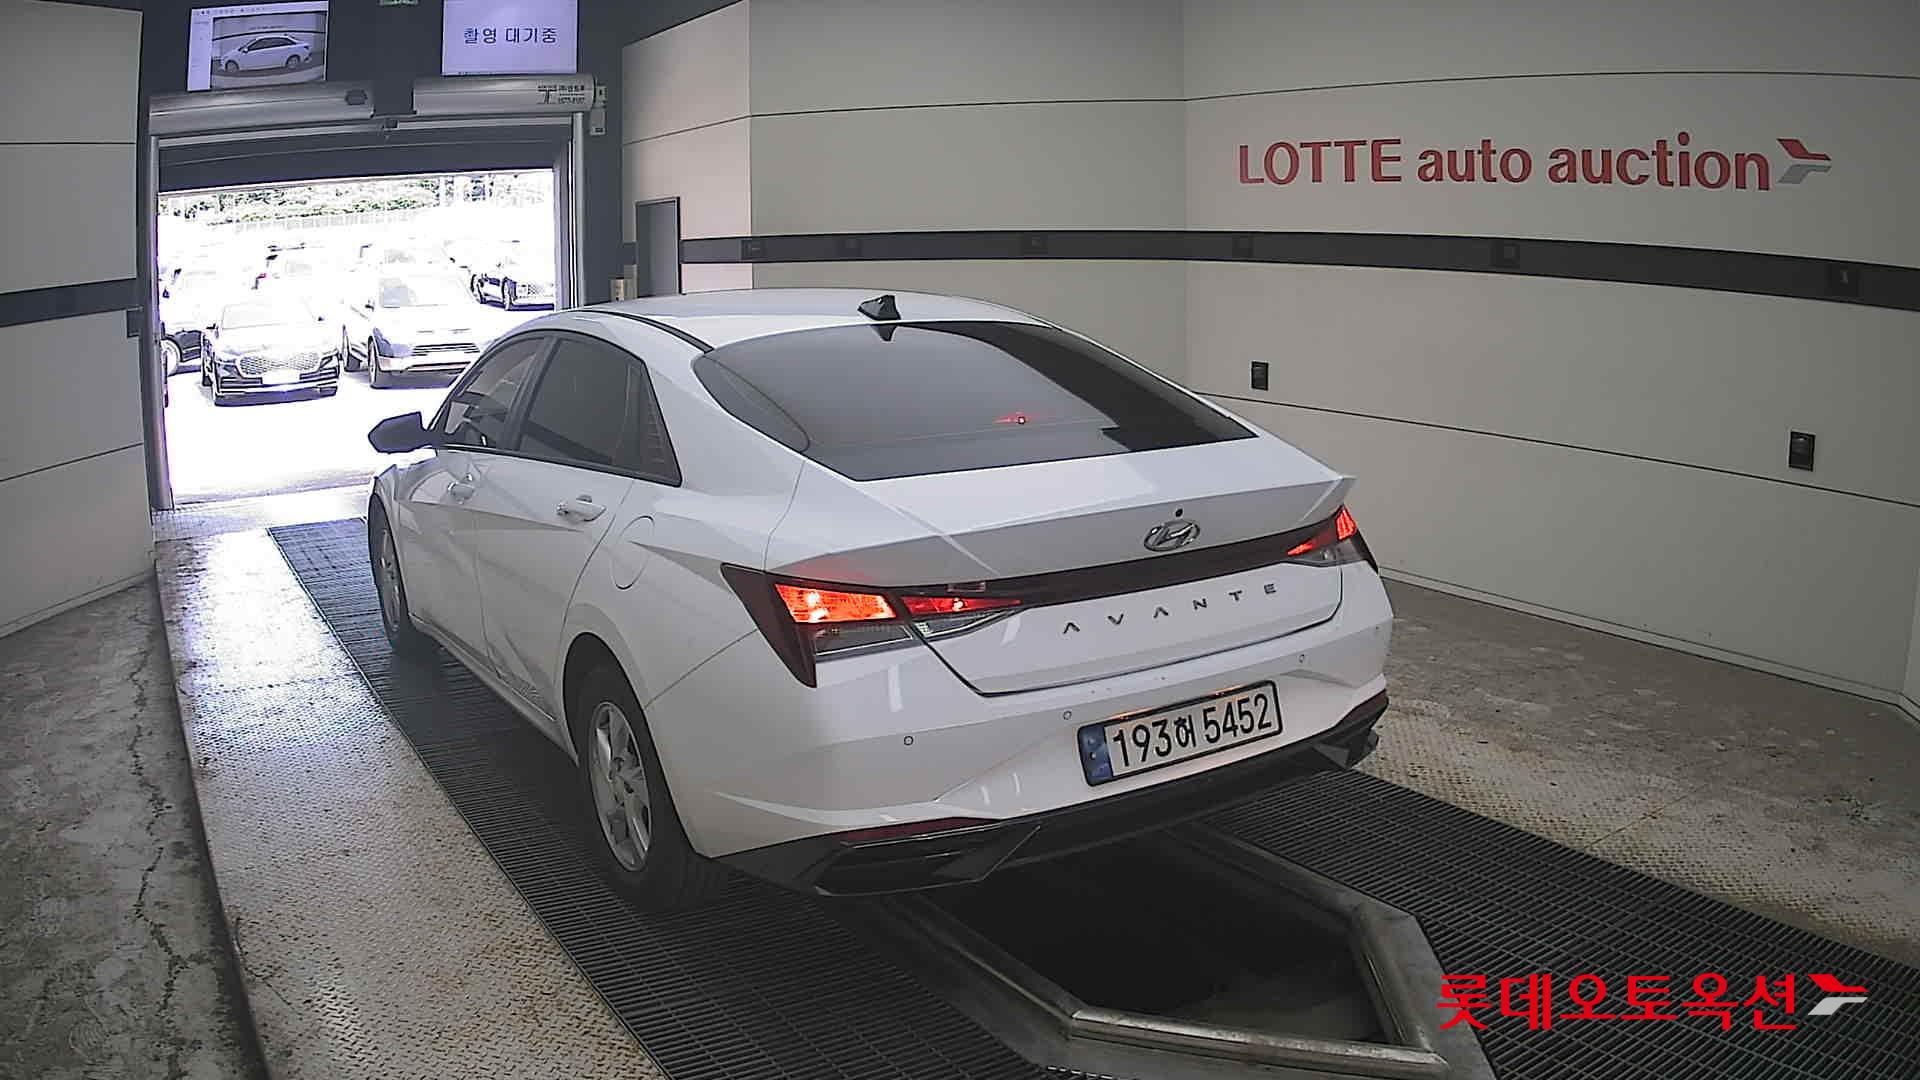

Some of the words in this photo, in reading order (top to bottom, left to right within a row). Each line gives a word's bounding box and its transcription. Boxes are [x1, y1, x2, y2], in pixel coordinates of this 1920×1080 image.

[464, 27, 497, 44] 촬영
[505, 27, 557, 44] 대기중
[1238, 138, 1401, 185] LOTTE
[1416, 139, 1532, 183] auto
[1548, 131, 1770, 191] auction
[1063, 583, 1277, 635] AVANTE
[1203, 693, 1273, 744] 5452
